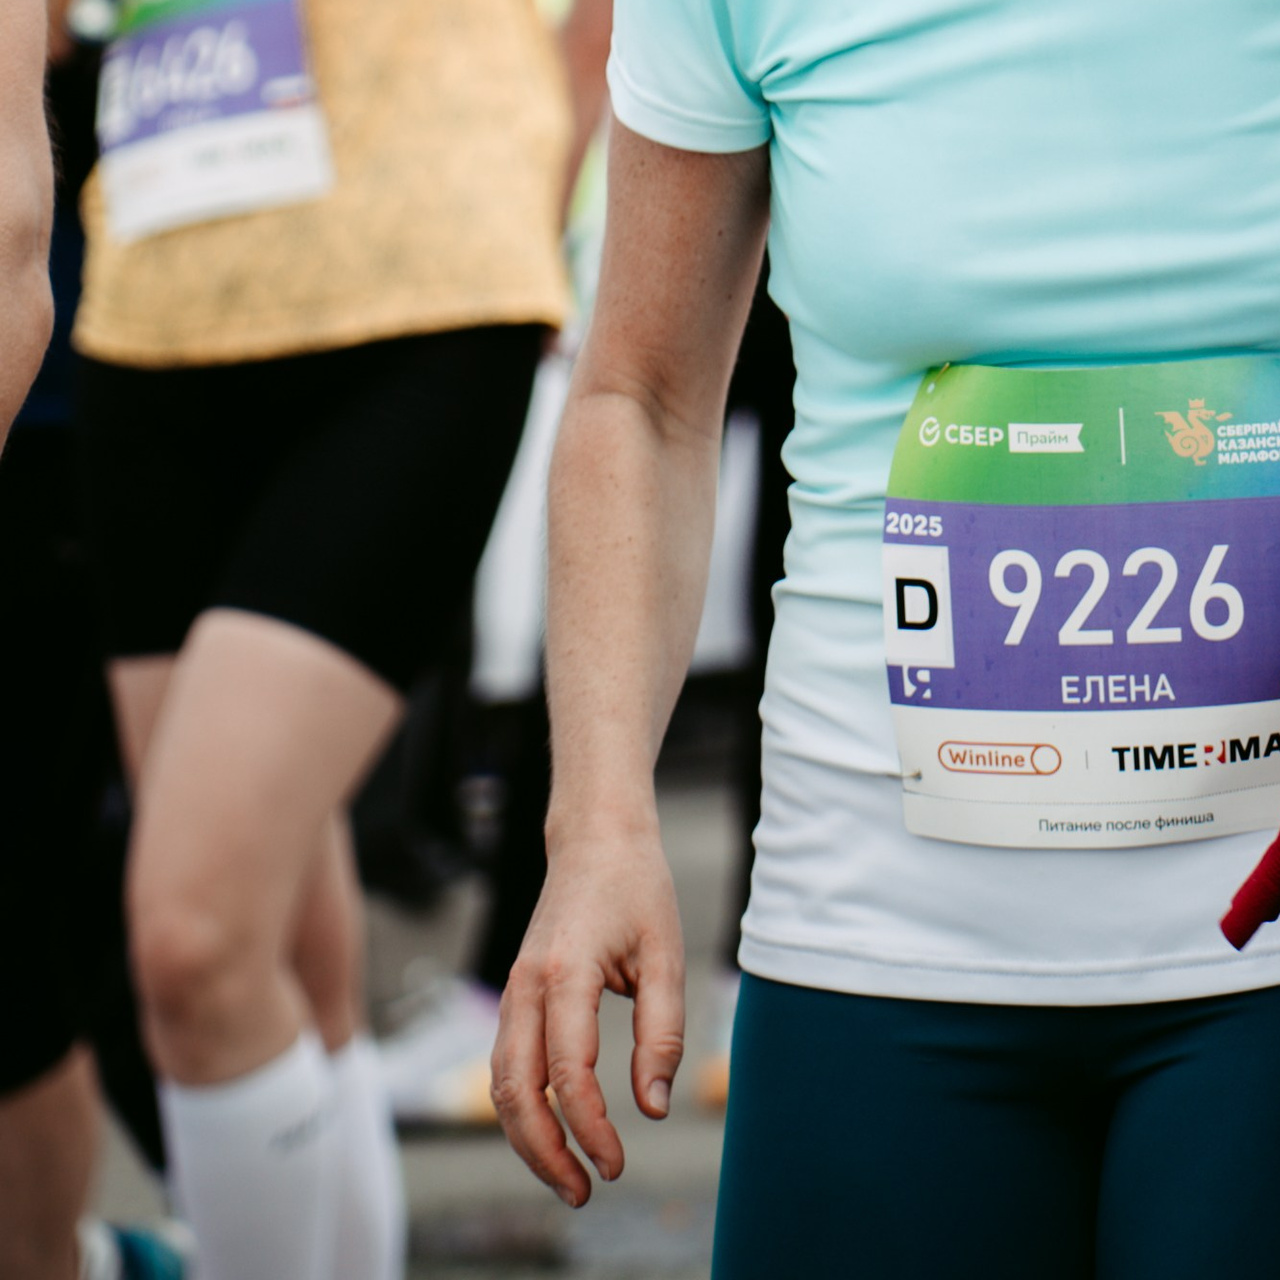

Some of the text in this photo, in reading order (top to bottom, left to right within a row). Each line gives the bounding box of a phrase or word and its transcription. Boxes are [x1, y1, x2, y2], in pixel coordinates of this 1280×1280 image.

[945, 423, 1068, 447] СБЕР Прайм
[886, 511, 943, 537] 2025
[895, 577, 939, 631] D
[988, 544, 1245, 646] 9226
[1060, 673, 1175, 705] ЕЛЕНА
[948, 747, 1025, 768] Winline
[1038, 812, 1215, 833] Питание после финиша
